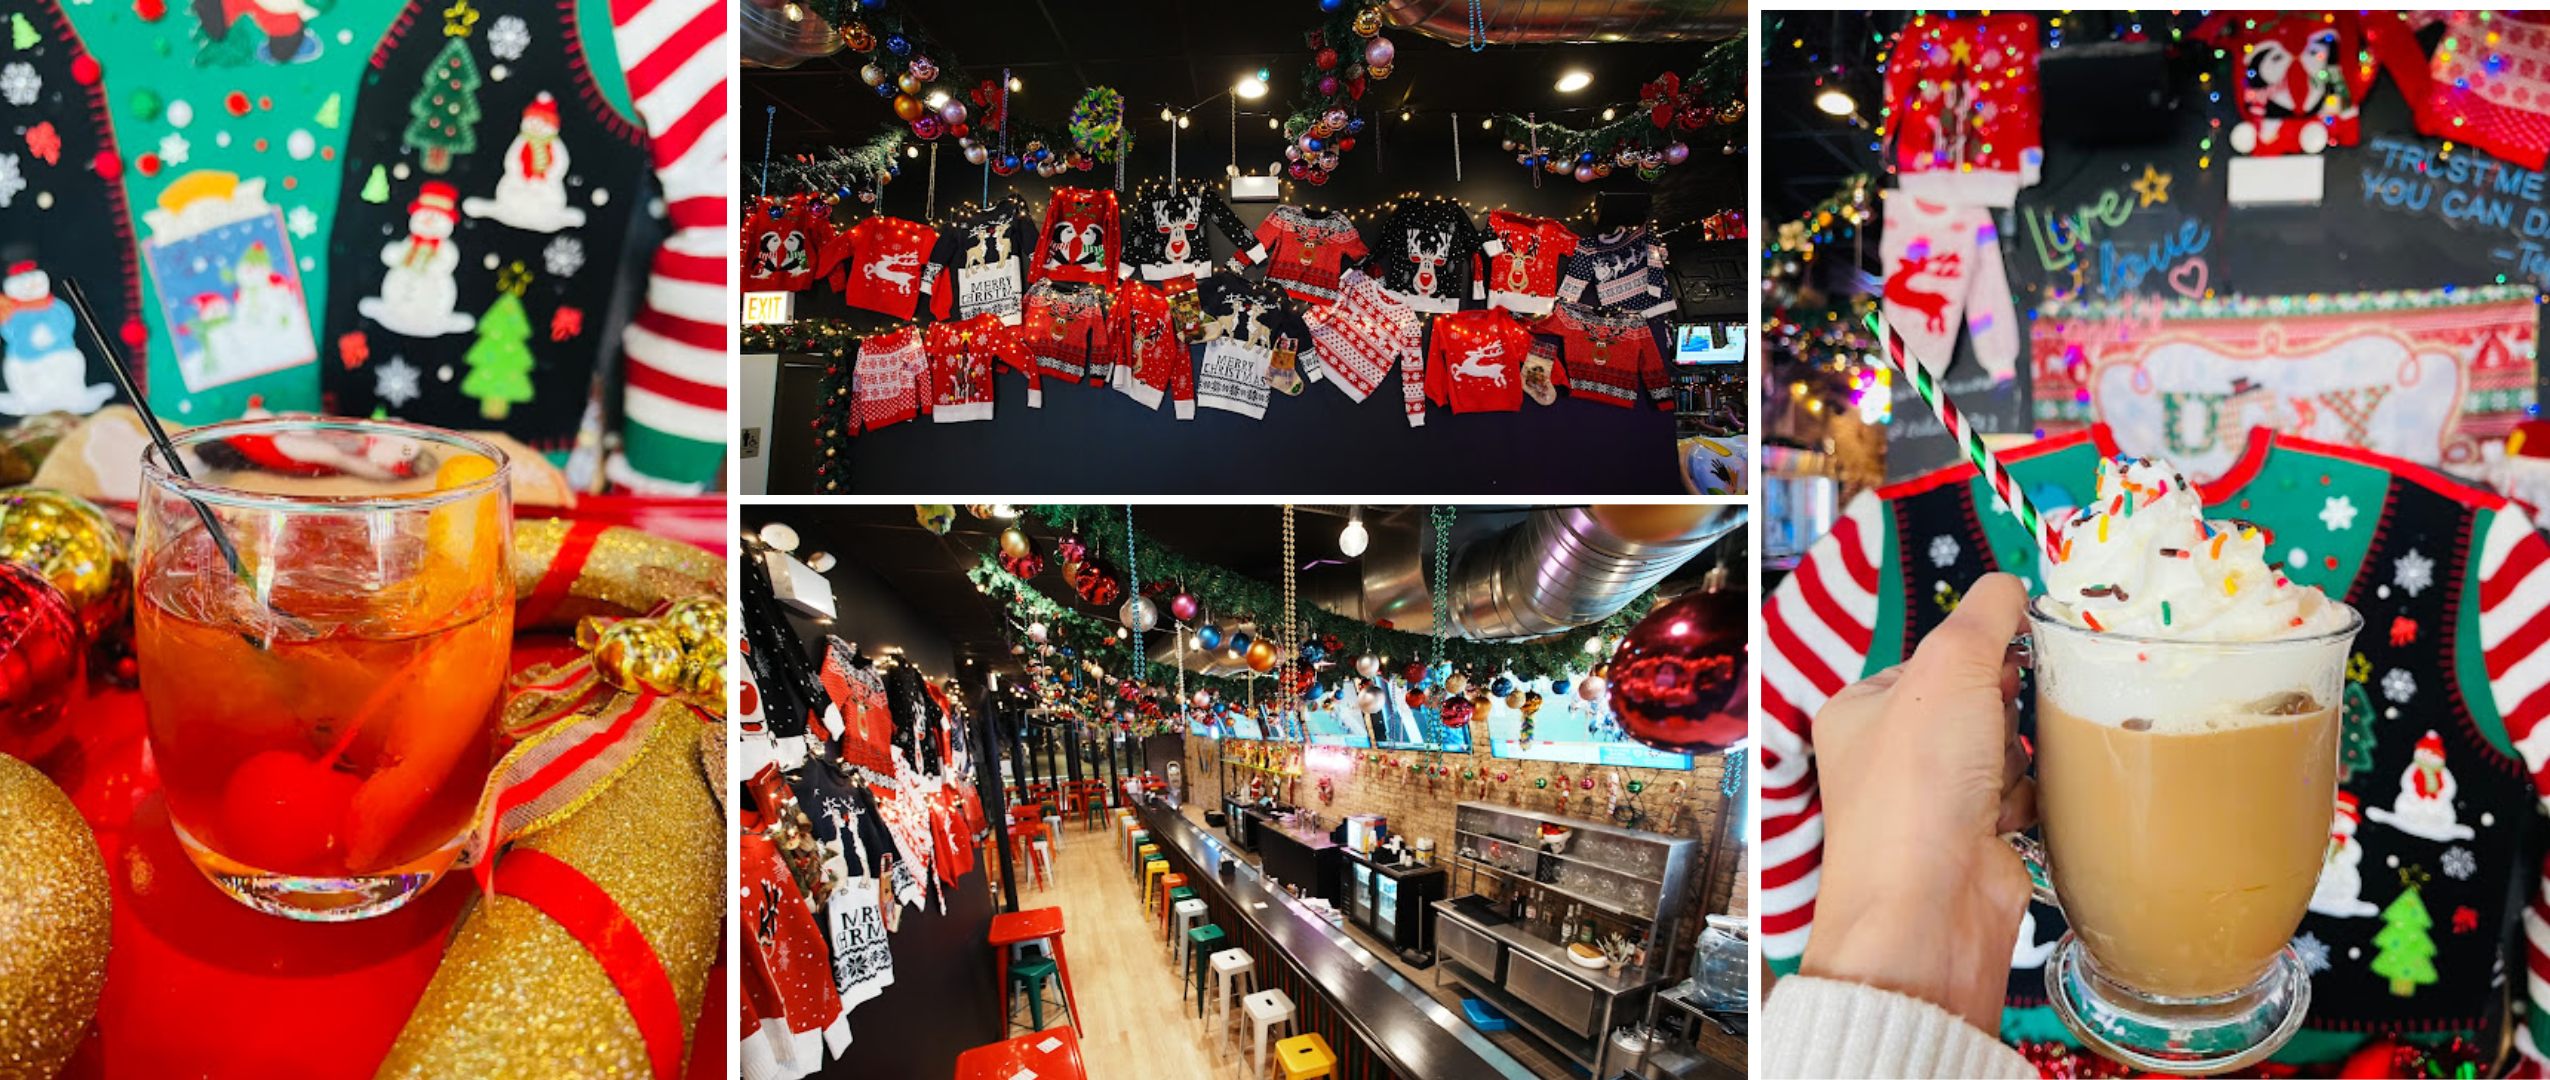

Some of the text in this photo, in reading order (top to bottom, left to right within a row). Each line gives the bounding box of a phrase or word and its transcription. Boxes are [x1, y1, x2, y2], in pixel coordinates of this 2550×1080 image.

[2493, 166, 2546, 201] ME
[2362, 169, 2550, 239] YOU CAN D
[2101, 218, 2211, 300] love
[971, 276, 1012, 293] MERRY
[748, 296, 782, 320] EXIT
[1203, 362, 1267, 387] CHRISTMAS
[1216, 354, 1255, 373] MERRY
[2158, 381, 2391, 456] UGY
